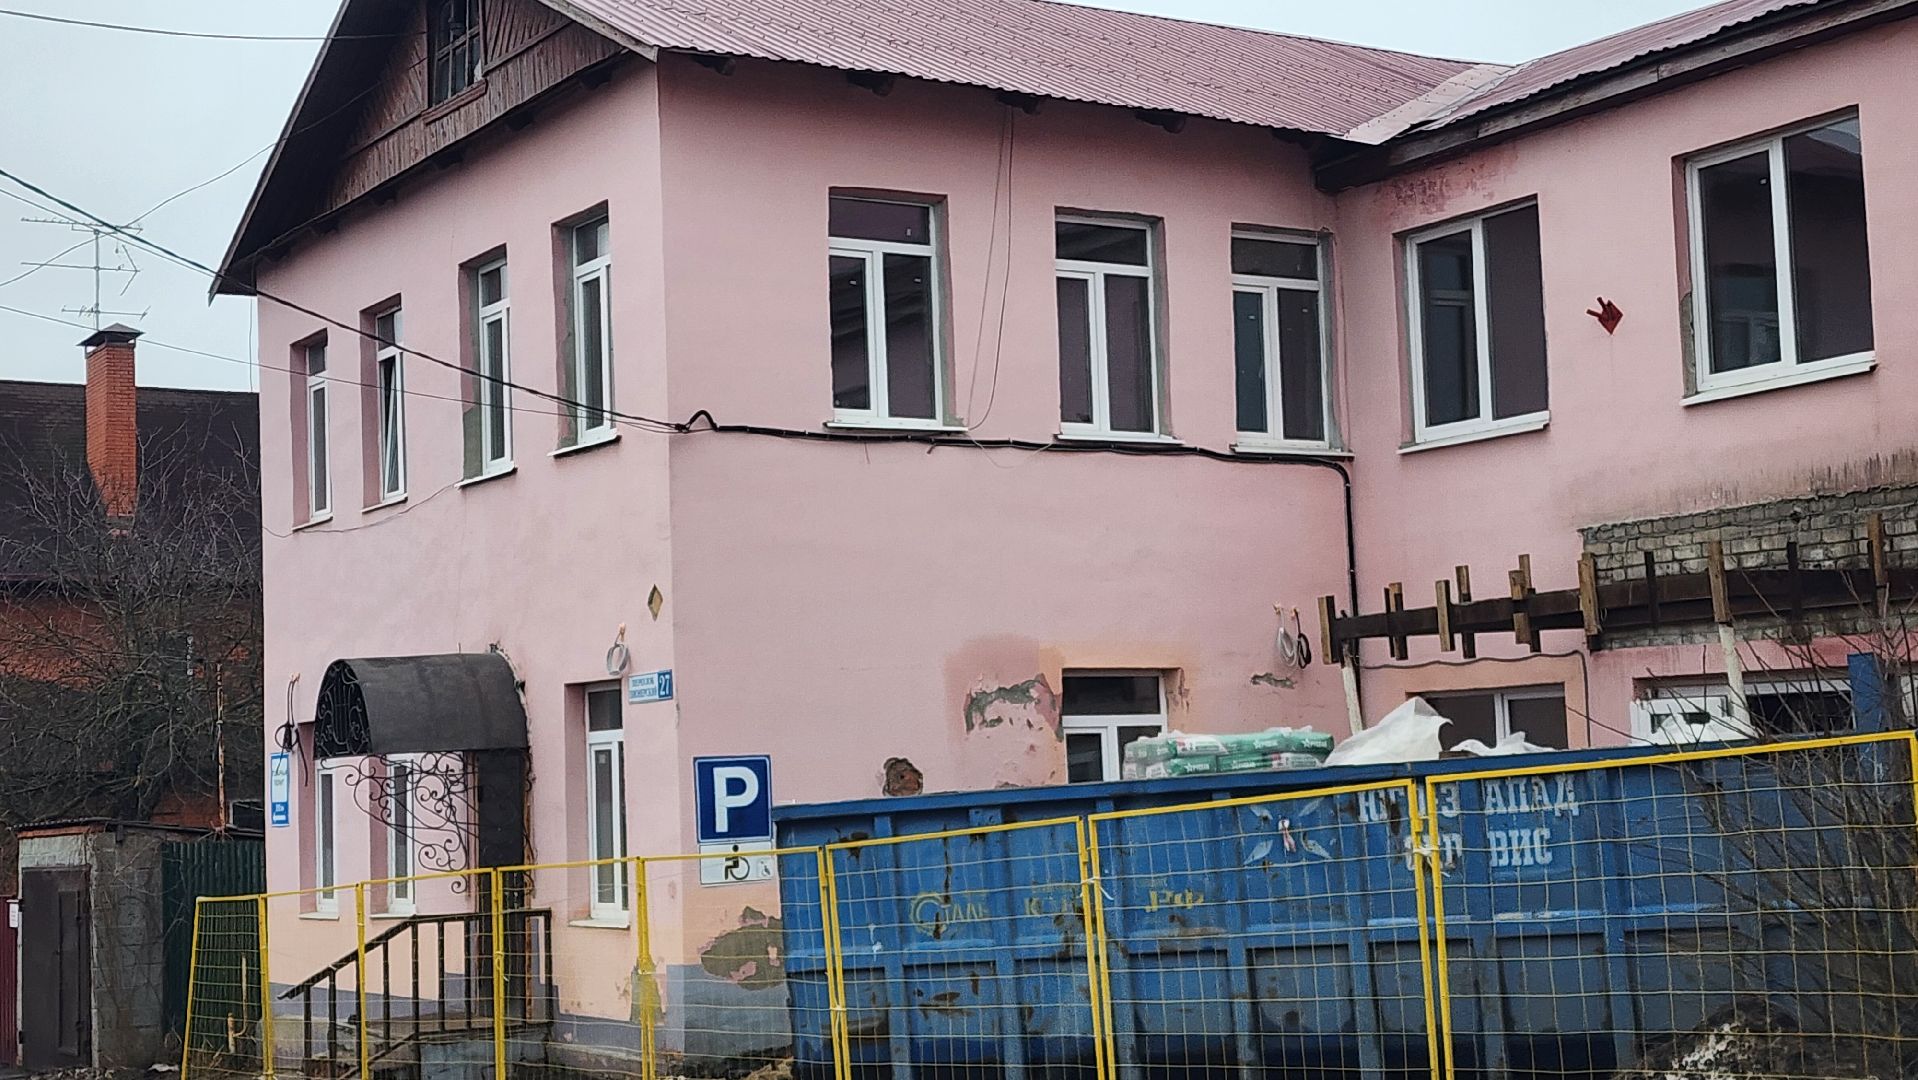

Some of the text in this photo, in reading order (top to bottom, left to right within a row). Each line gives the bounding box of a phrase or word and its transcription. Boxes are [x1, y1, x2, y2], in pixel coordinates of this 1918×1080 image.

[659, 674, 671, 696] 27
[712, 766, 759, 833] P
[1487, 827, 1553, 867] ВИС
